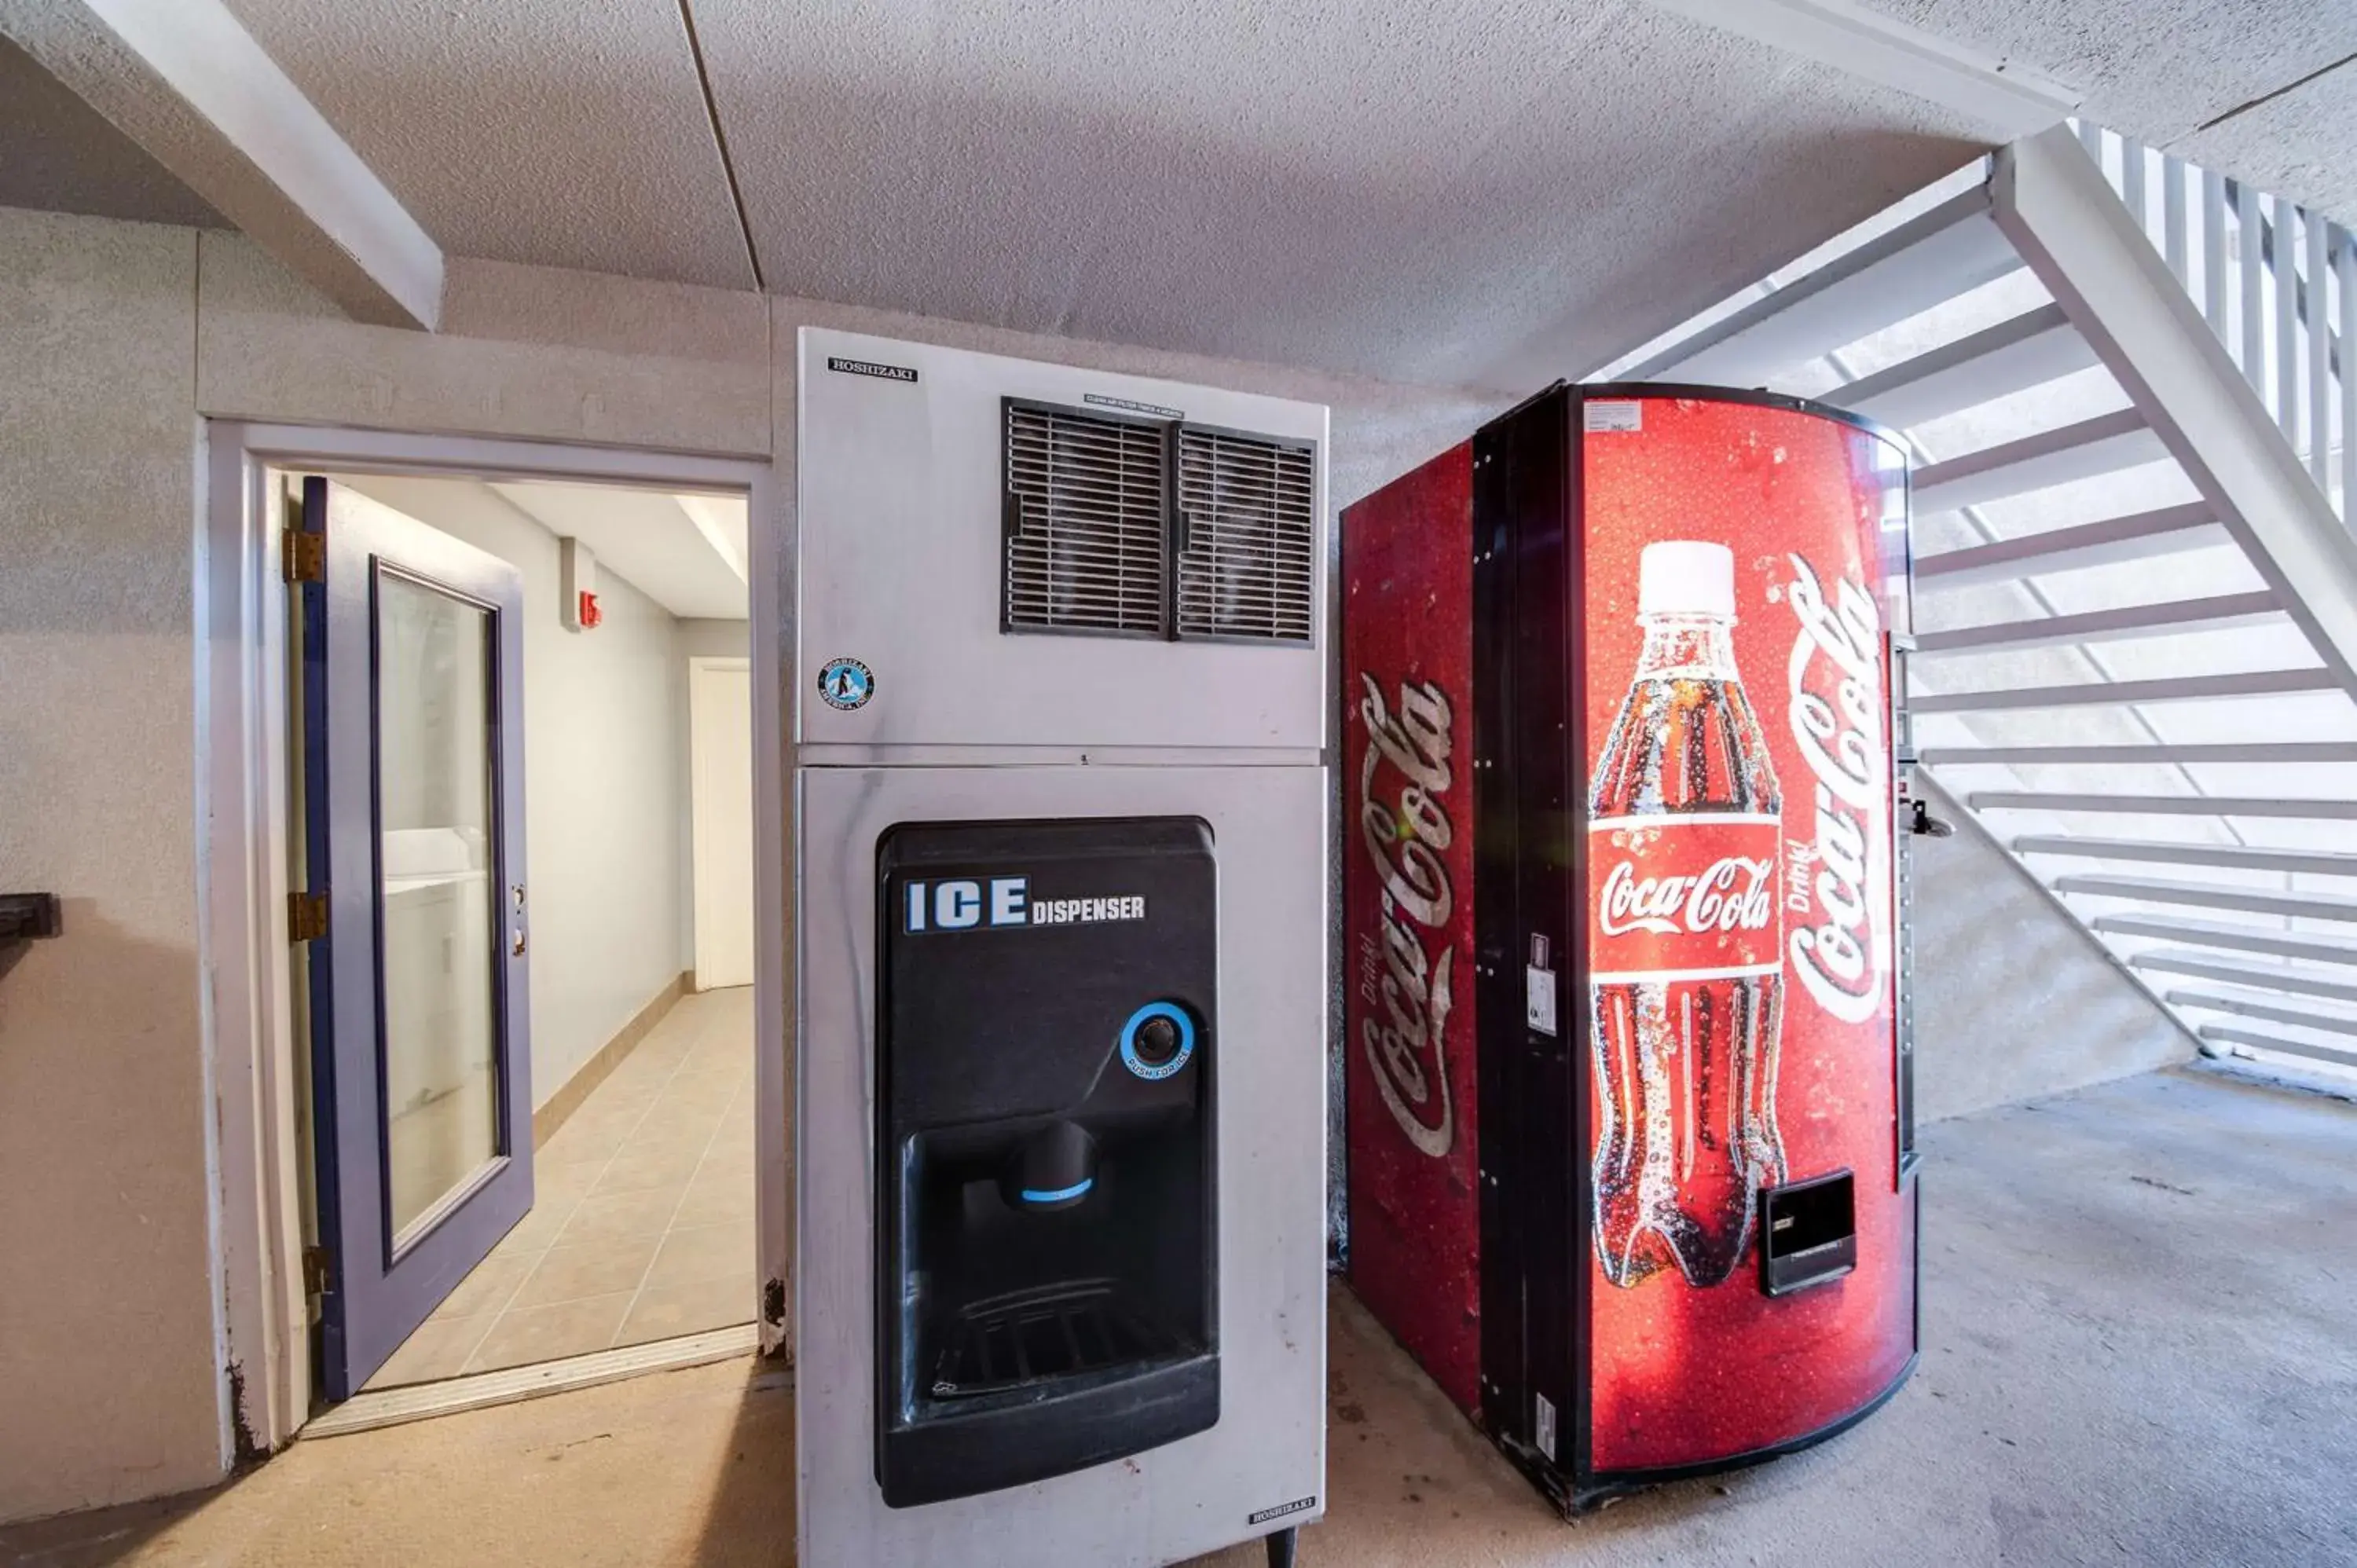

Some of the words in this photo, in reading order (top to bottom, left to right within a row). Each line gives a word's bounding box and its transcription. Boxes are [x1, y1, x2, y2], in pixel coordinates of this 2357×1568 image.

[833, 359, 912, 380] HOSHIZAKI
[909, 877, 1027, 931] ICE
[1032, 896, 1145, 925] DISPENSER
[1600, 856, 1773, 936] Coca-Cola
